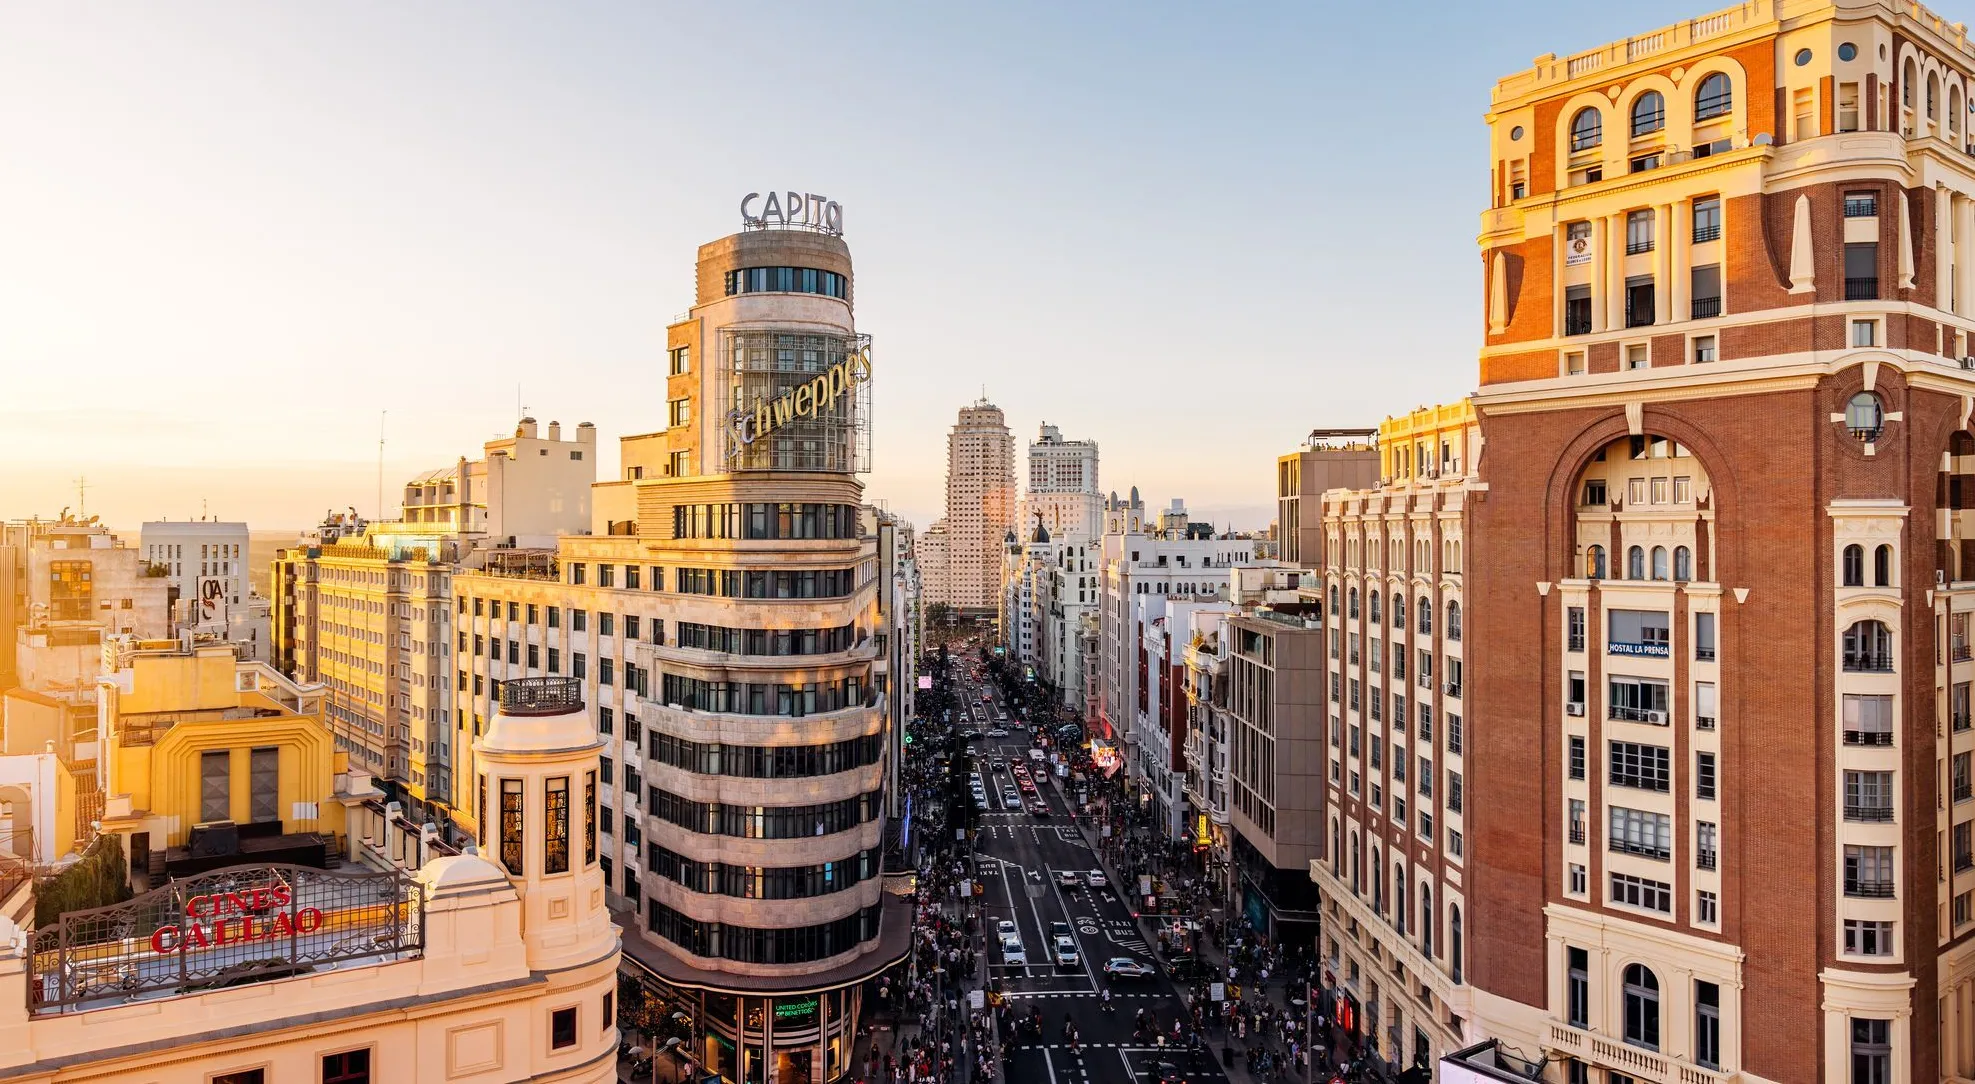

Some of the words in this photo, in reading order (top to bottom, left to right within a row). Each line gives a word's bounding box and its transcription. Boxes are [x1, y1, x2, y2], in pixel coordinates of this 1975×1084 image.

[725, 344, 871, 461] Schweppes
[1609, 643, 1633, 653] HOSTAL
[1634, 645, 1643, 653] LA
[1644, 646, 1669, 655] PRENSA
[186, 885, 292, 919] CINES
[151, 907, 323, 954] CALLAO
[1223, 1002, 1229, 1010] P
